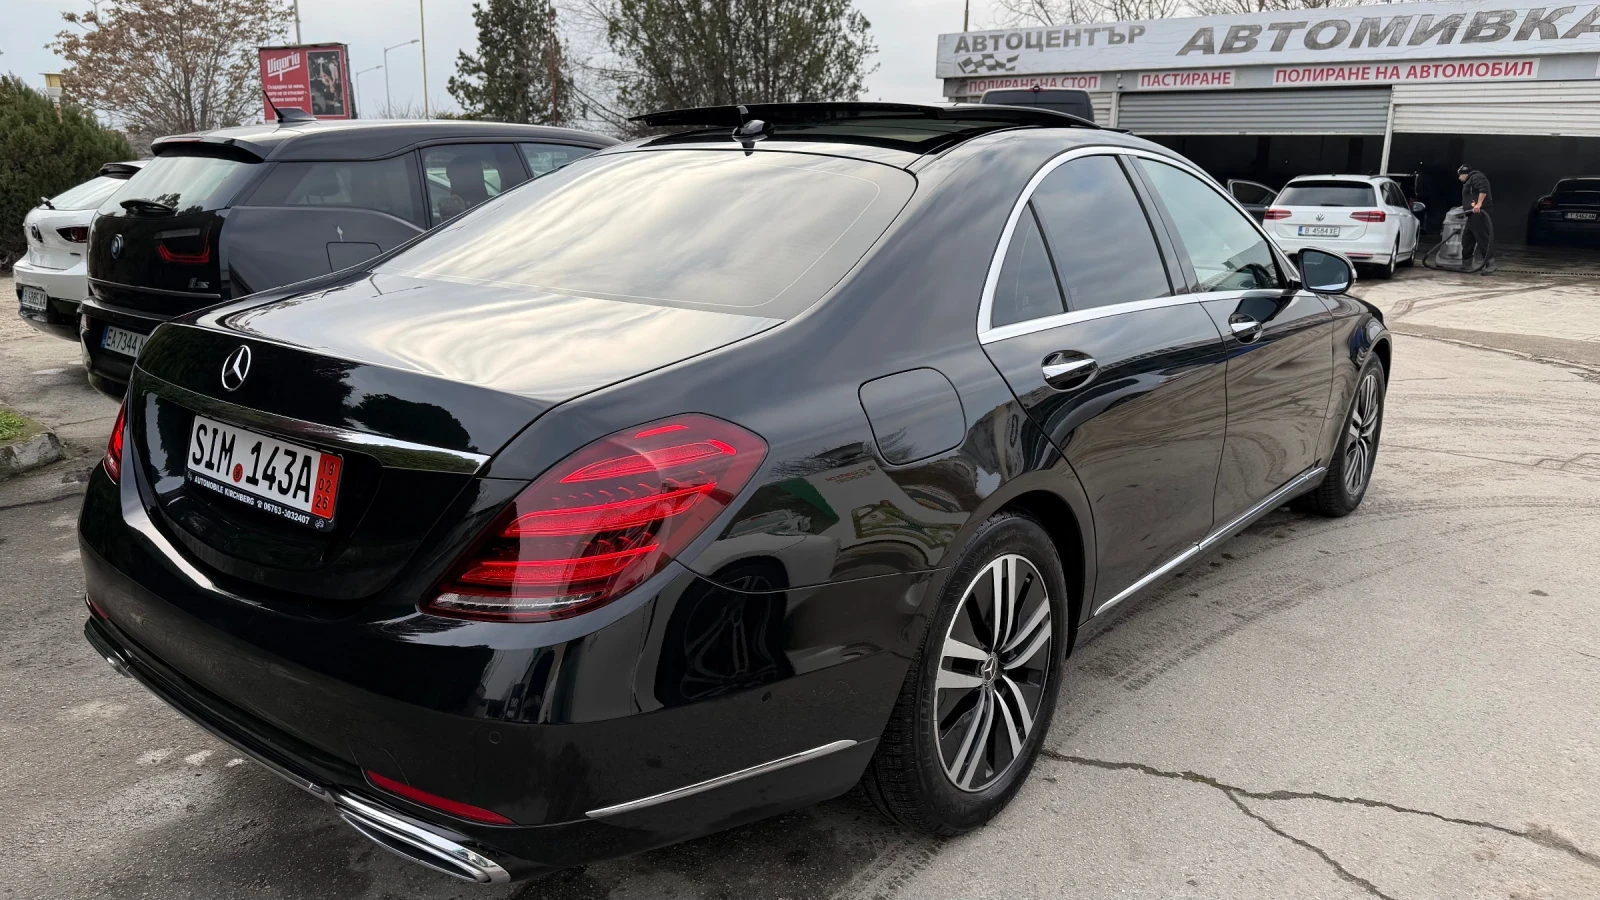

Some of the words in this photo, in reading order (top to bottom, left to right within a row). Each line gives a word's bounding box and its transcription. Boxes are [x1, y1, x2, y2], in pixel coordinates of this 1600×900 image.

[954, 25, 1146, 53] АВТОЦЕНТЪР
[1175, 5, 1600, 56] АВТОМИВКА
[1140, 71, 1231, 87] ПАСТИРАНЕ
[1275, 66, 1371, 83] ПОЛИРАНЕ
[1375, 65, 1401, 80] НА
[1406, 61, 1534, 79] АВТОМОБИЛ
[968, 78, 1037, 92] ПОЛИРАНЕ
[1039, 77, 1059, 89] НА
[1061, 75, 1098, 89] СТОП
[116, 331, 138, 355] 7344
[192, 423, 236, 477] SIM
[246, 440, 313, 504] 143A
[322, 460, 336, 476] 19
[194, 475, 224, 495] AUTOMOBILE
[224, 487, 255, 506] KIRCHBERG
[318, 478, 333, 494] 02
[315, 494, 329, 510] 26
